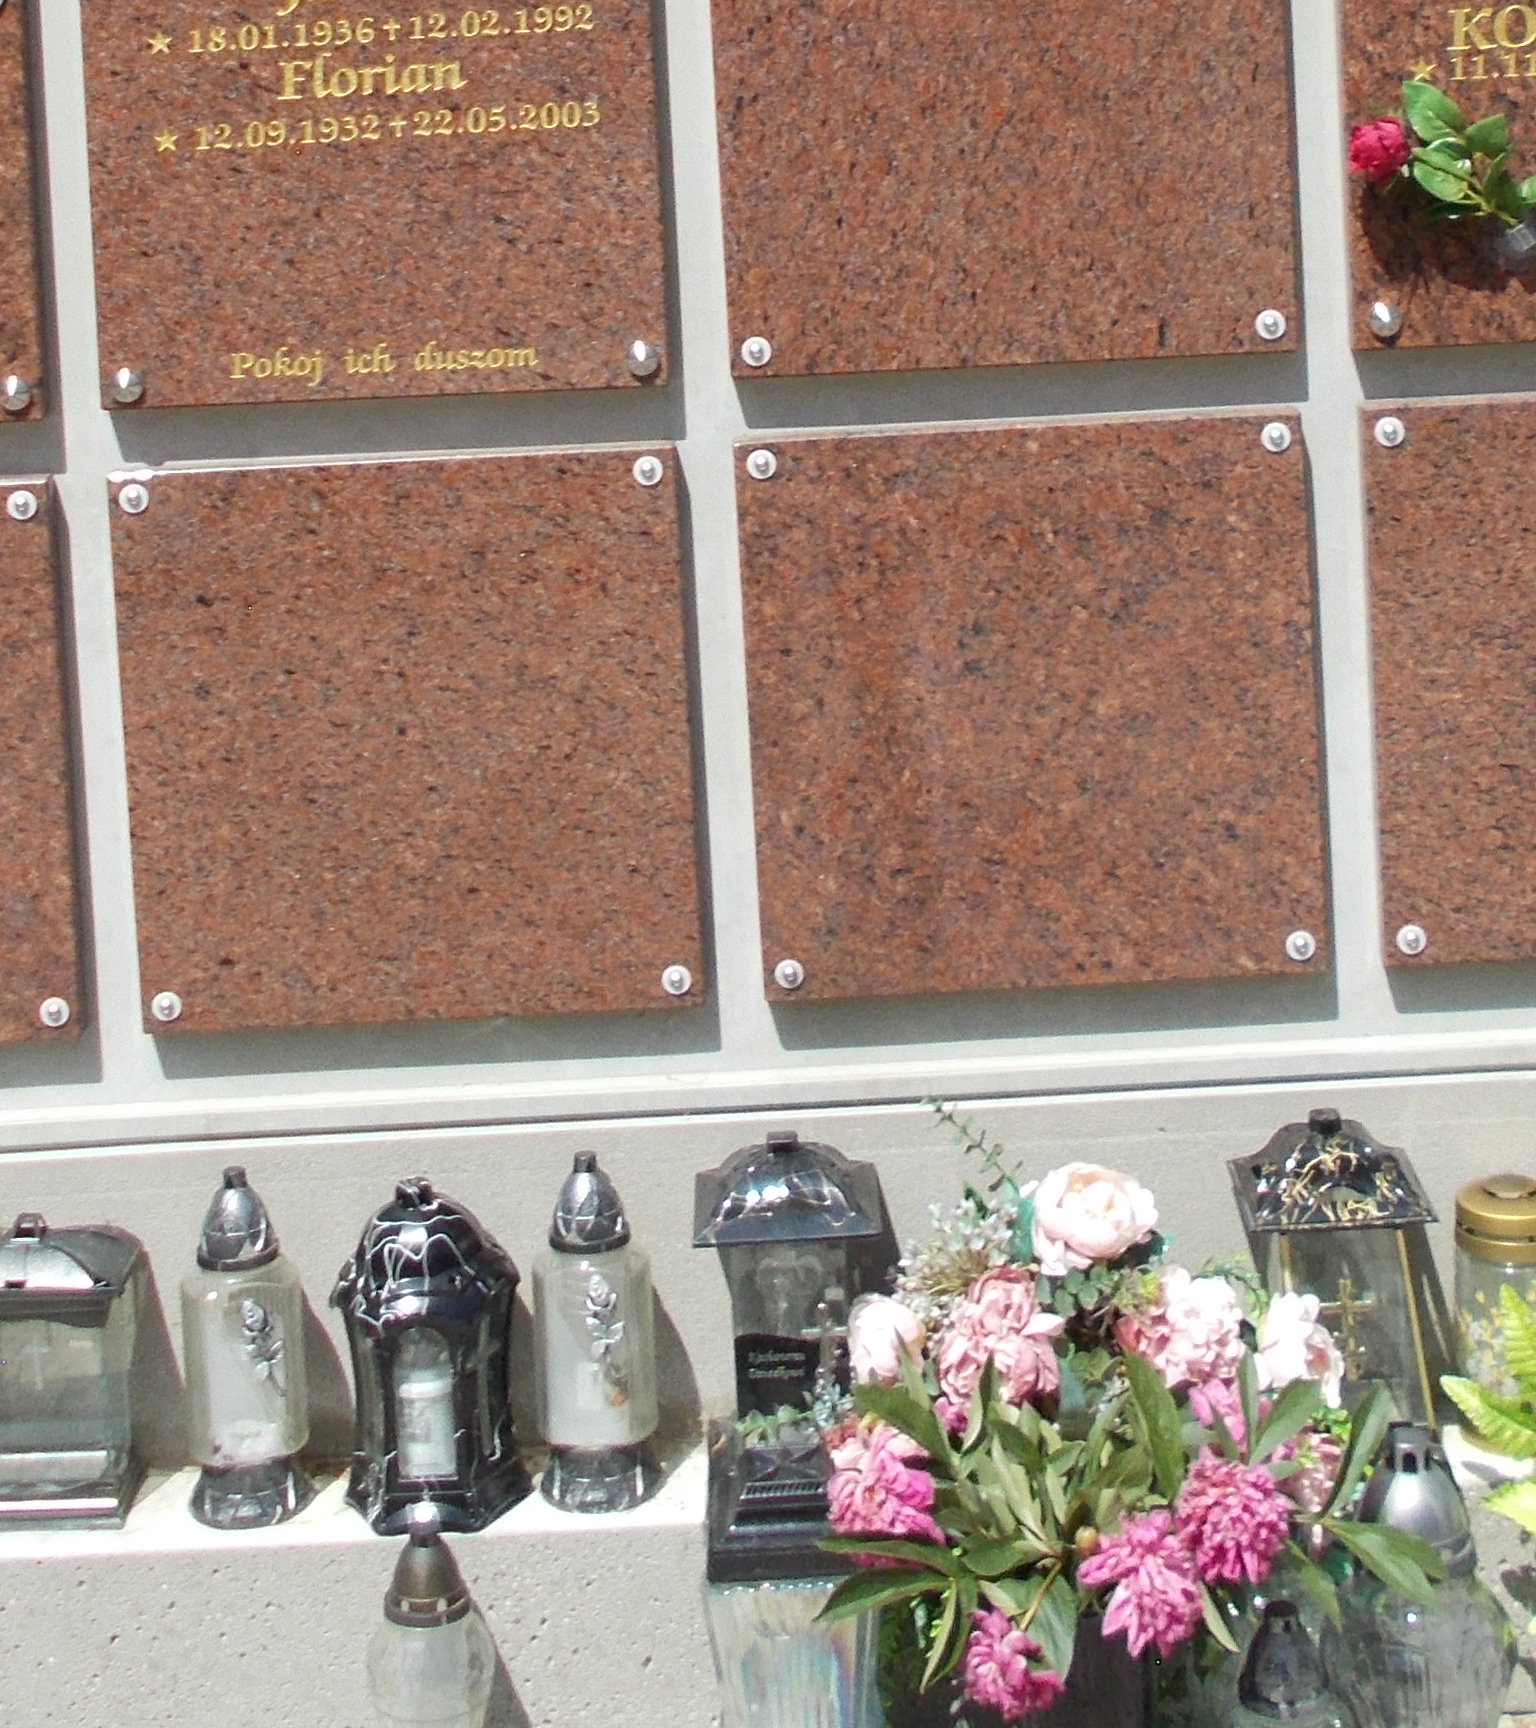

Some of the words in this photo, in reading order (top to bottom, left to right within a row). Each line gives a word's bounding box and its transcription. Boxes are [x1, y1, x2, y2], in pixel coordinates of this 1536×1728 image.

[188, 16, 375, 53] 18.01.1936
[408, 3, 594, 39] 12.02.1992
[277, 53, 468, 101] Florian
[195, 114, 381, 151] 12.09.1932
[413, 101, 601, 136] 22.05.2003
[343, 343, 395, 374] ich
[414, 341, 539, 372] duszom
